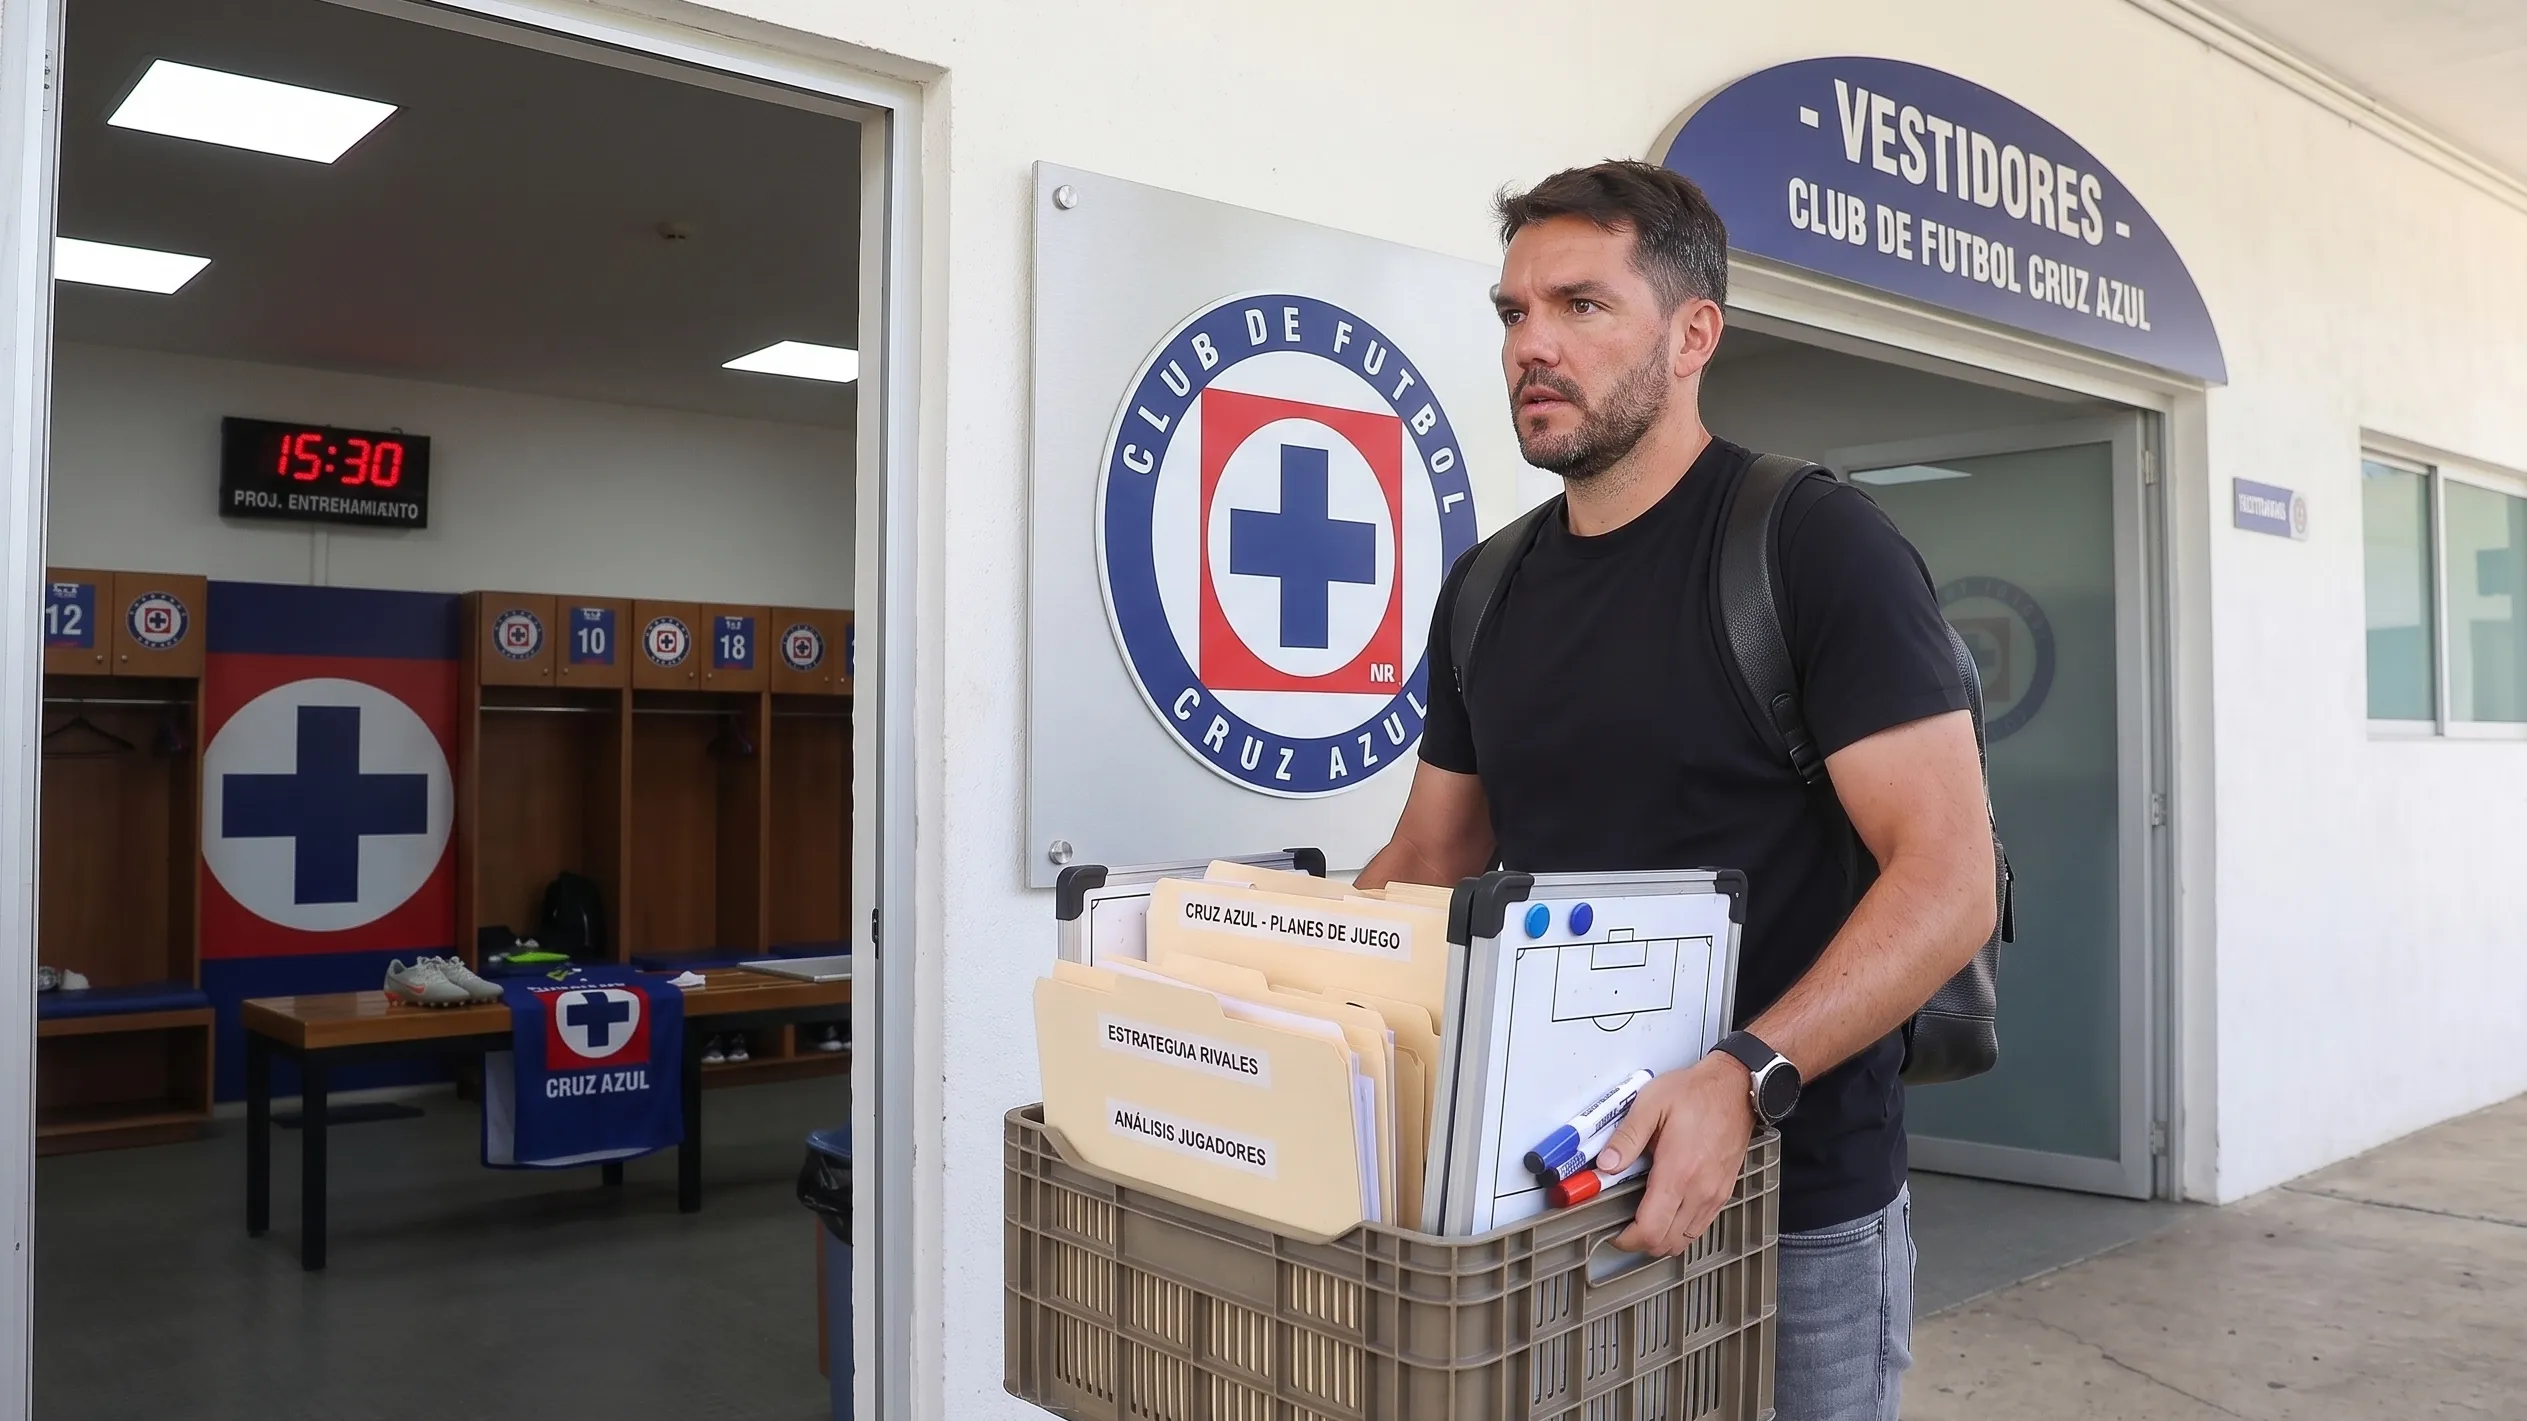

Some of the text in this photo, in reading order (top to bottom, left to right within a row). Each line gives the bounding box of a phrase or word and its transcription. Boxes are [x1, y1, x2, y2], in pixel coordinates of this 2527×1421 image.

[1833, 78, 2103, 246] VESTIDORES
[1788, 177, 2151, 332] CLUB DE FUTBOL CRUZ AZUL
[1121, 306, 1466, 515] CLUB DE FUTBOL
[278, 433, 404, 488] 15:30
[234, 489, 282, 509] PROJ.
[45, 603, 83, 635] 12
[577, 627, 606, 655] 10
[720, 634, 746, 660] 18
[1370, 663, 1395, 683] NR
[1172, 687, 1427, 782] CRUZ AZUL
[1185, 902, 1221, 922] CRUZ
[1223, 907, 1258, 928] AZUL
[1270, 914, 1323, 938] PLANES
[1327, 923, 1346, 942] DE
[1350, 926, 1400, 950] JUEGO
[1200, 1046, 1259, 1075] RIVALES
[545, 1070, 650, 1099] CRUZ AZUL
[1114, 1110, 1266, 1166] ANÁLISIS JUGADORES
